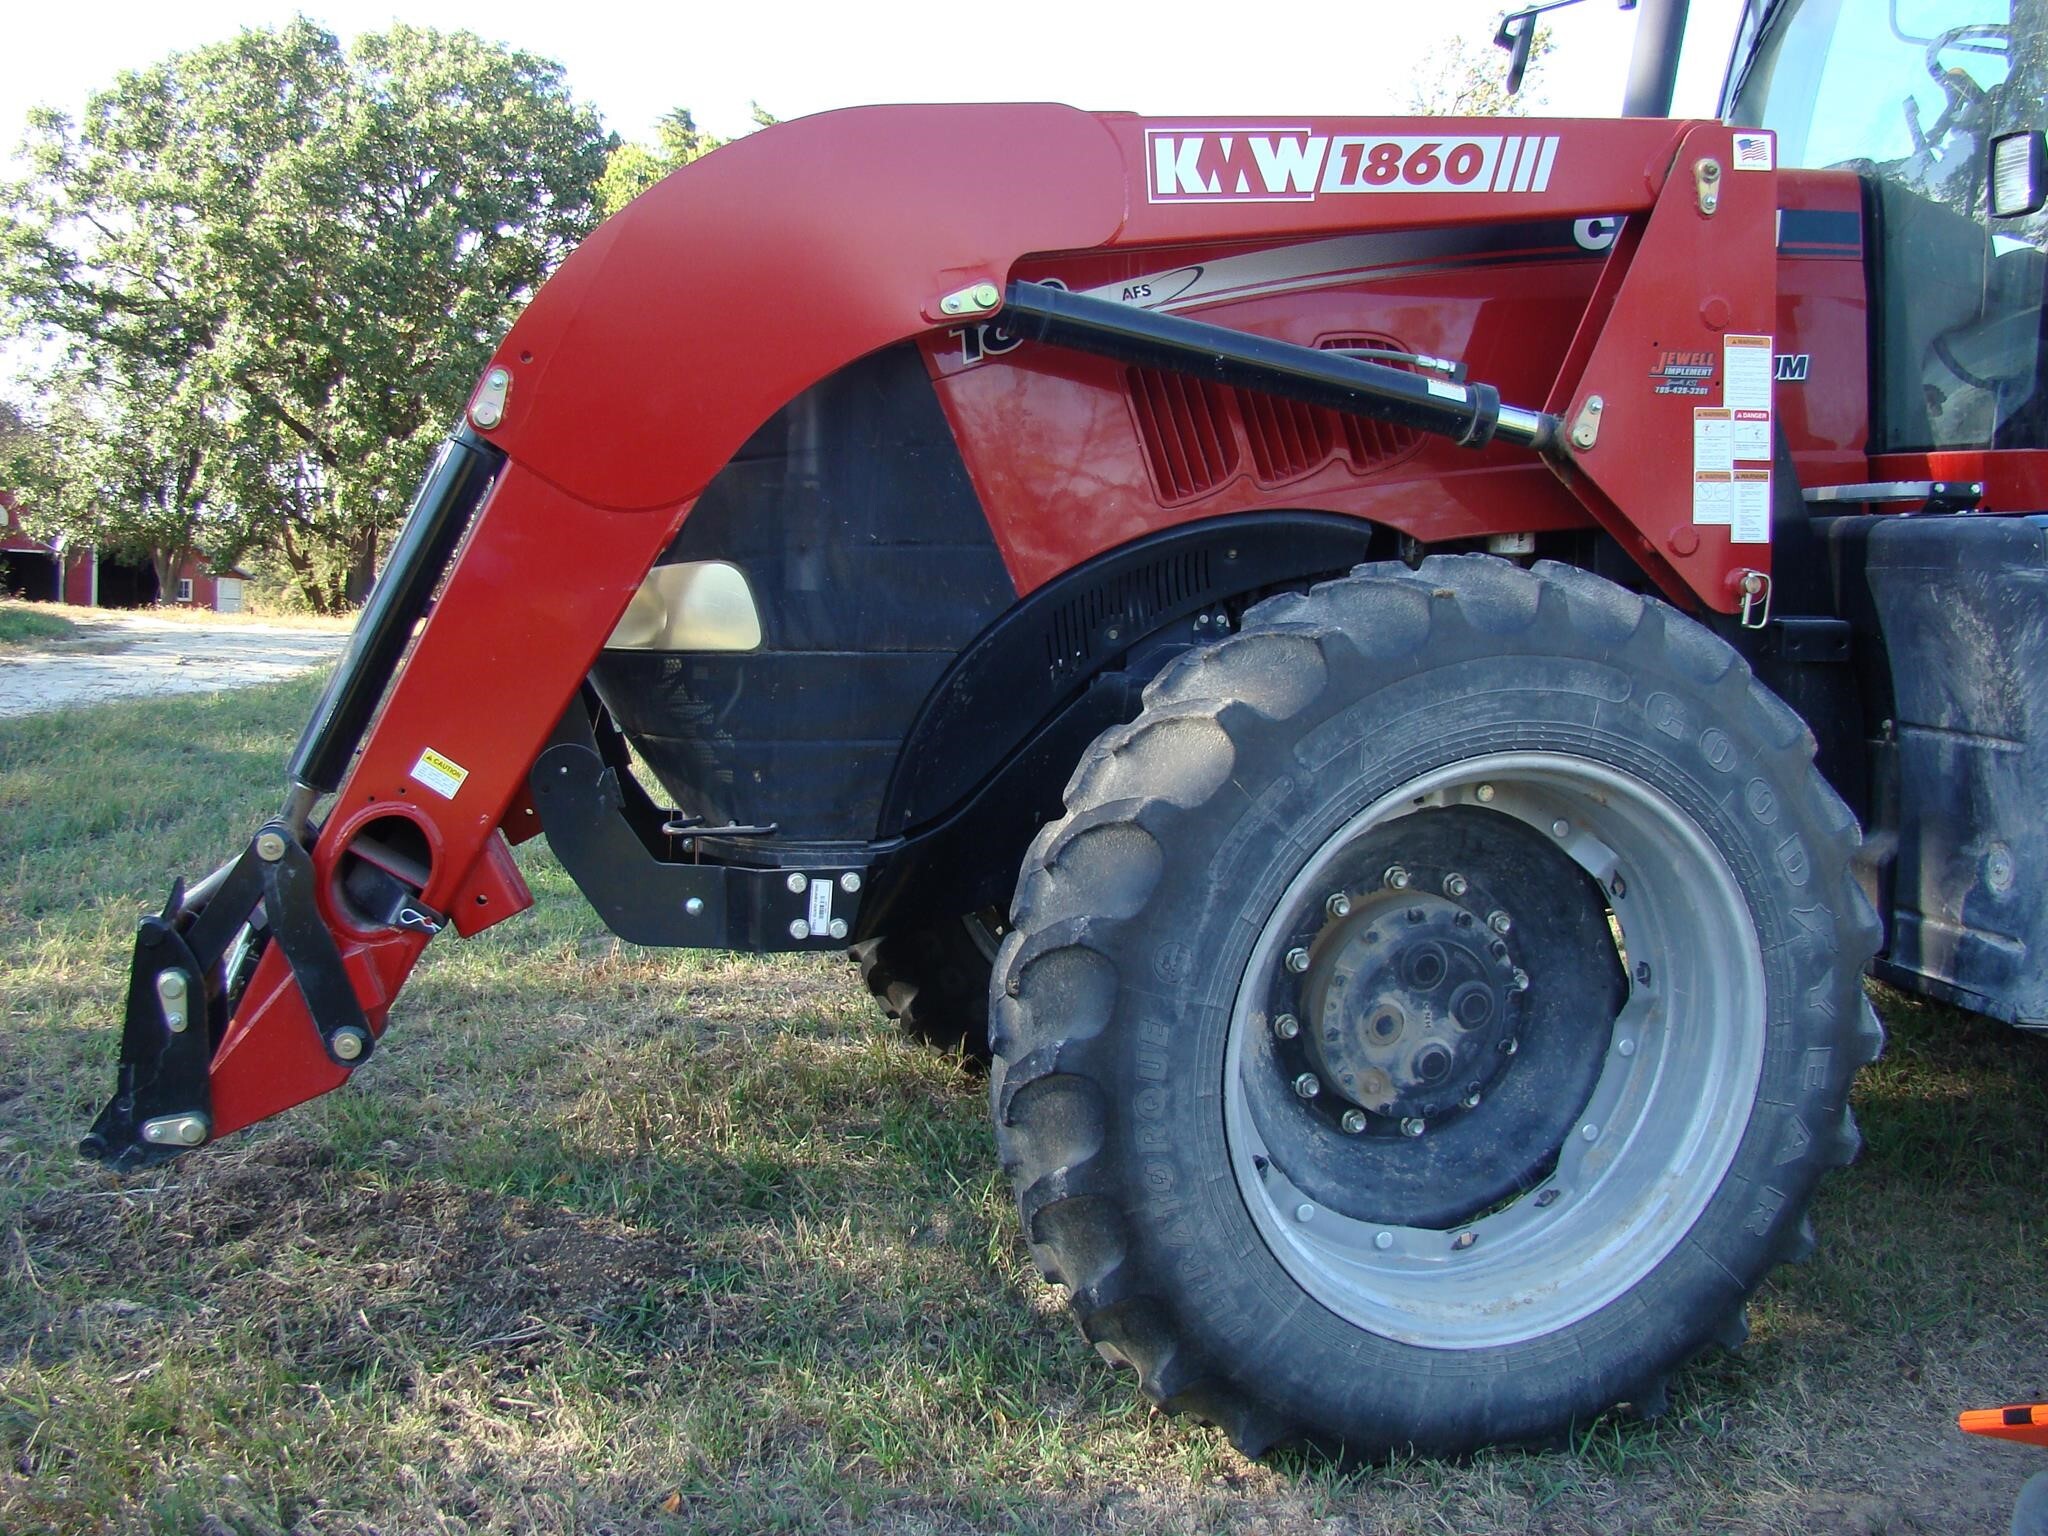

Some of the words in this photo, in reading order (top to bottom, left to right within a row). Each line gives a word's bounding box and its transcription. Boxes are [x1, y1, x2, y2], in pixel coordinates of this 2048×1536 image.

[1154, 136, 1329, 194] KMW
[1339, 142, 1485, 186] 1860
[1122, 284, 1152, 301] AFS
[1651, 352, 1715, 373] JEWELL
[1664, 367, 1713, 376] IMPLEMENT
[434, 758, 462, 778] CAUTION
